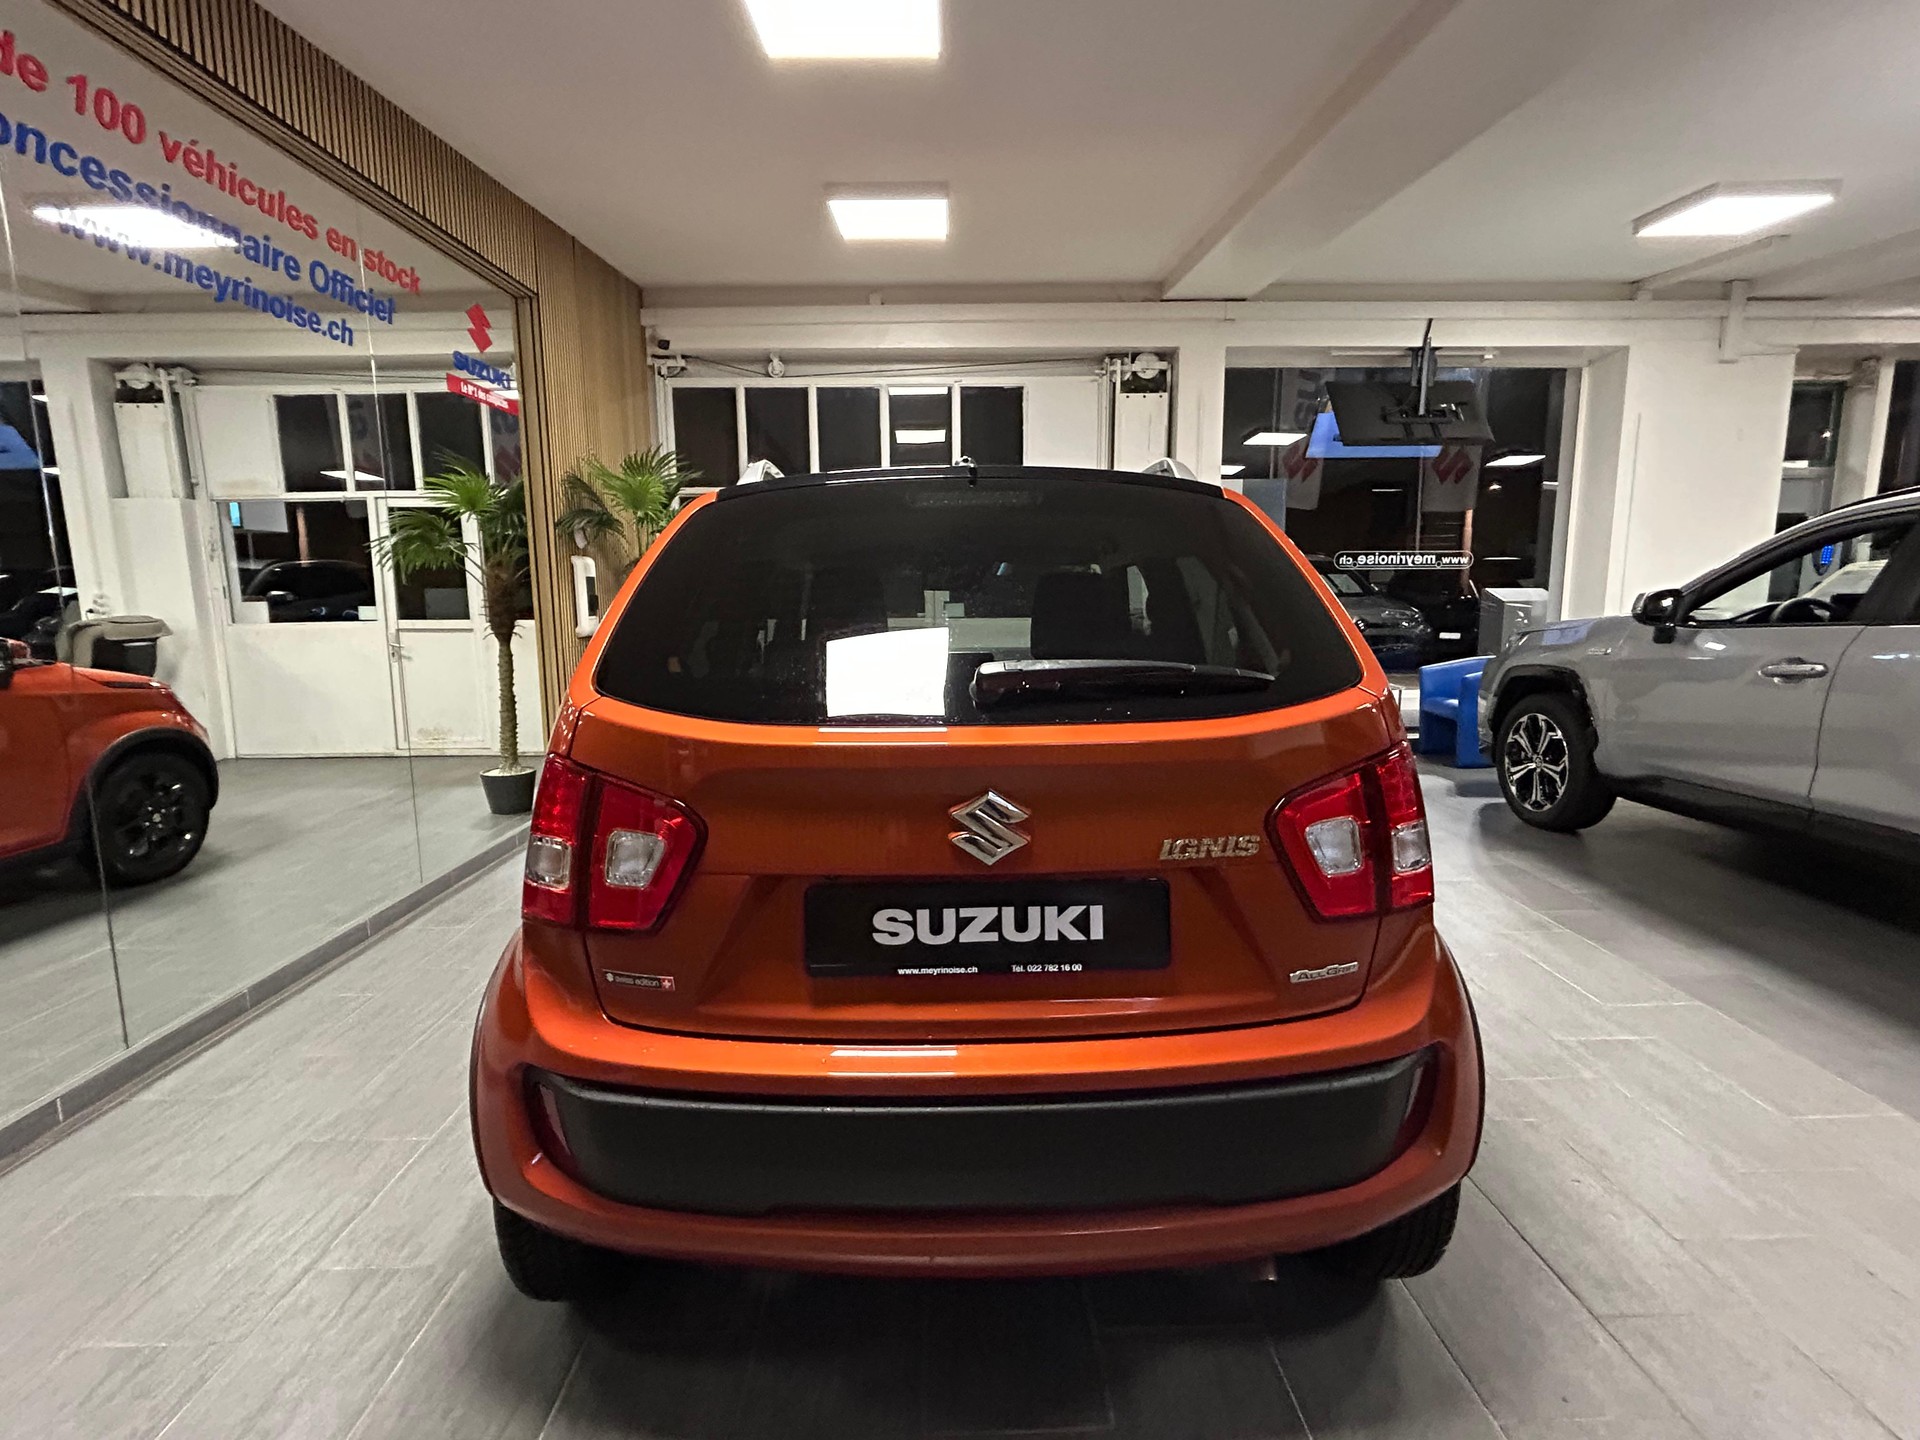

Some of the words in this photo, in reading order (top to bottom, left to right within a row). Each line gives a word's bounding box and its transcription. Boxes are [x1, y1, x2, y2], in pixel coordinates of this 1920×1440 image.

[66, 74, 146, 145] 100
[159, 130, 319, 240] véhicules
[325, 227, 358, 262] en
[363, 247, 421, 295] stock
[53, 202, 354, 346] www.meyrinoise.ch
[309, 260, 396, 325] Officiel
[453, 350, 512, 391] SUZUKI
[1159, 835, 1261, 860] IGNIS
[872, 905, 1104, 945] SUZUKI
[897, 965, 979, 976] www.meyrinoise.ch
[1027, 964, 1042, 972] 022
[1044, 964, 1059, 972] 782
[1060, 964, 1071, 972] 16
[1071, 963, 1083, 972] 00
